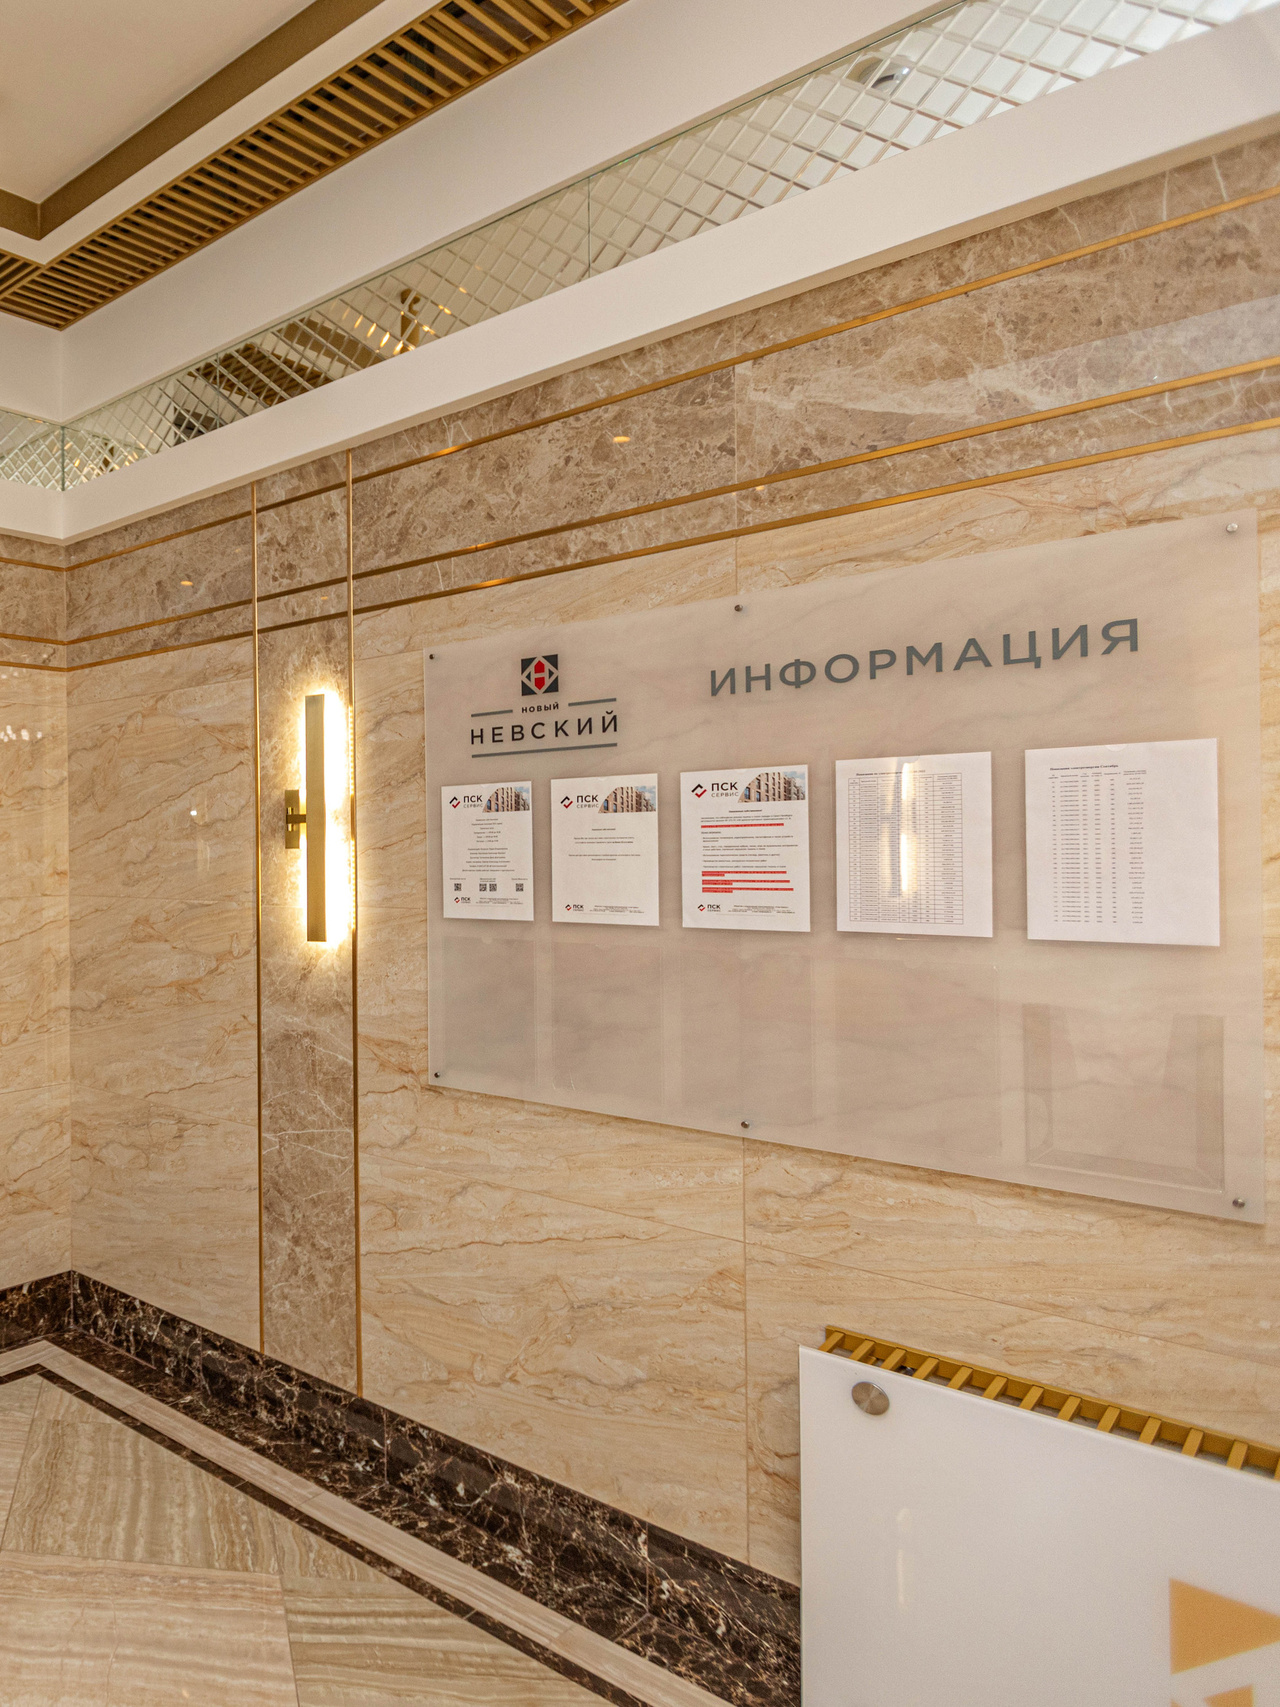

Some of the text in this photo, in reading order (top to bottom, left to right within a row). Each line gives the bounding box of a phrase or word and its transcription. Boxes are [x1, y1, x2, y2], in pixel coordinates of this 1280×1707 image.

[710, 618, 1140, 697] ИНФОРМАЦИЯ
[521, 702, 560, 714] НОВЫЙ
[470, 710, 618, 745] НЕВСКИЙ
[711, 782, 738, 791] ПСК
[463, 795, 483, 803] ПСК
[576, 795, 599, 803] ПСК
